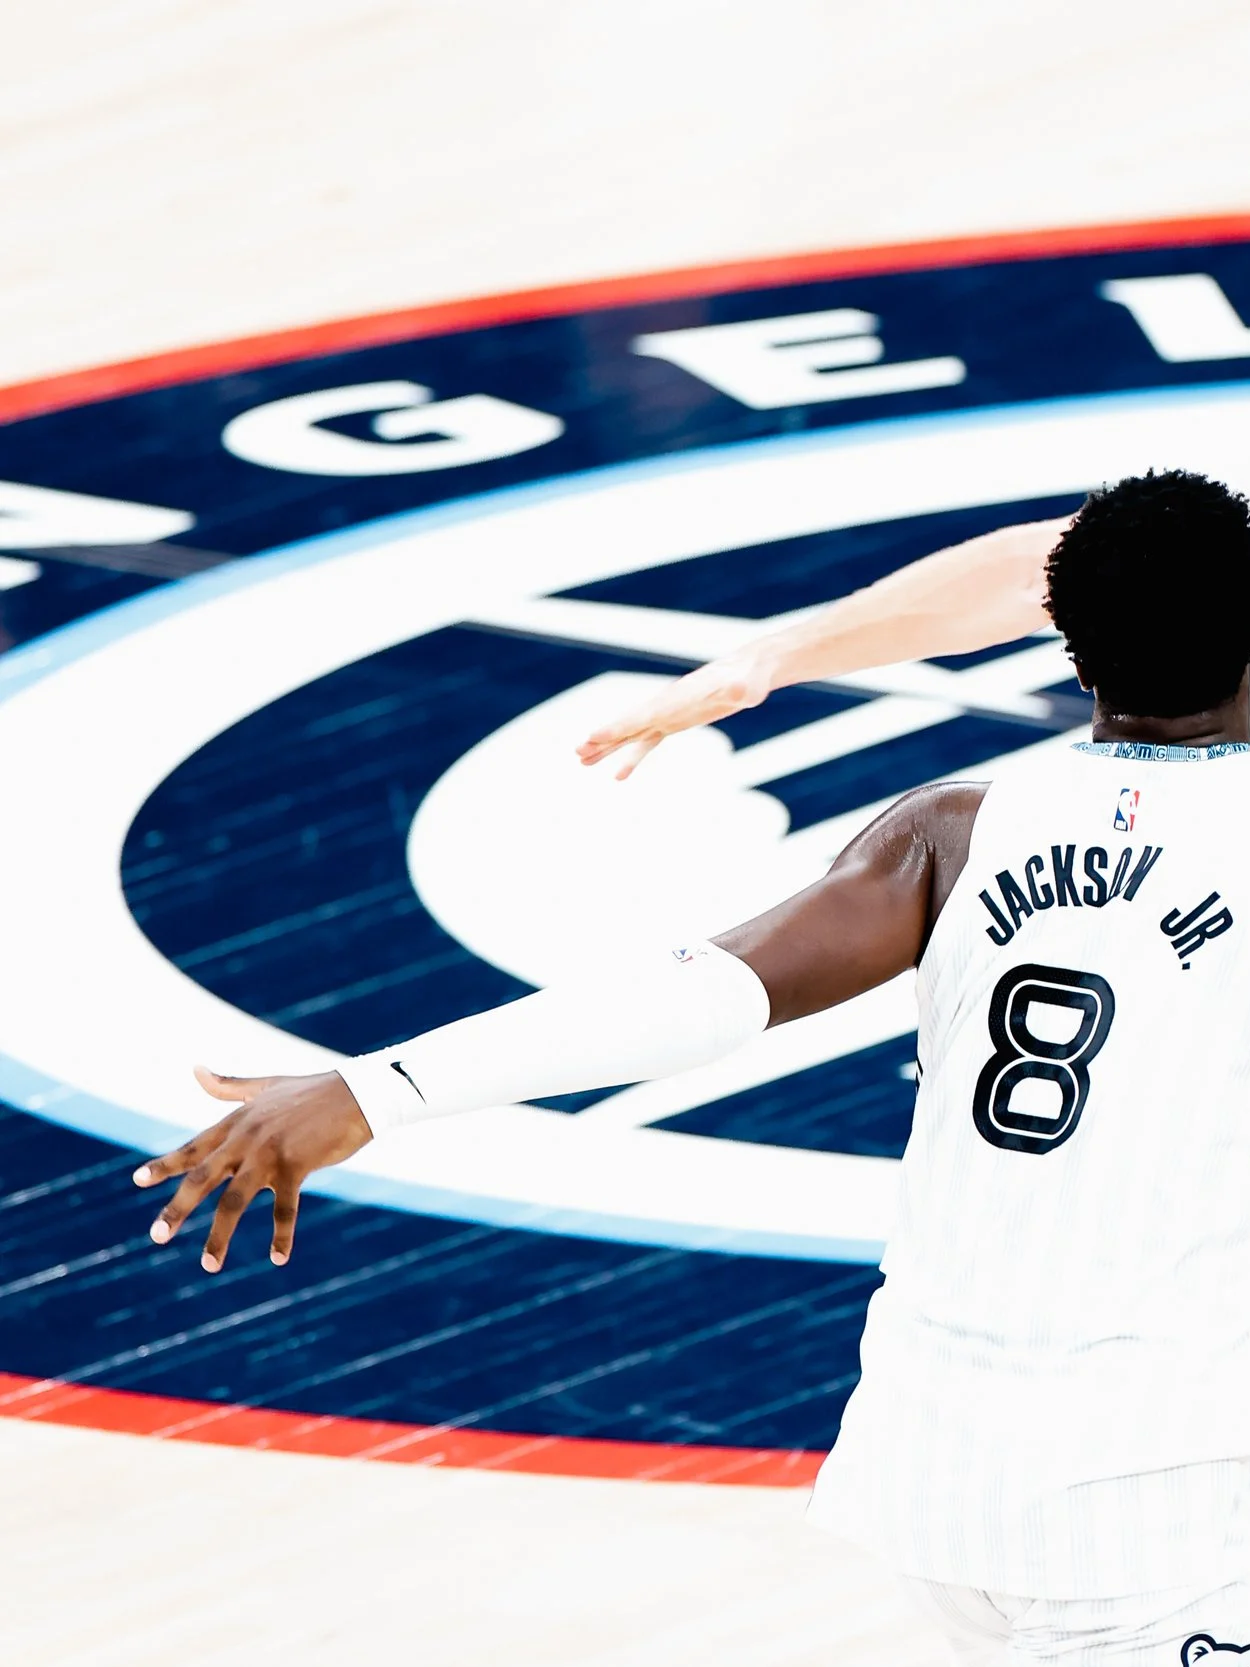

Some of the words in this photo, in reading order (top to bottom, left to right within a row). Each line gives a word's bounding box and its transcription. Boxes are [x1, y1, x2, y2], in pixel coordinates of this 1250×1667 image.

[979, 844, 1164, 946] JACKSON
[1160, 891, 1234, 970] JR.
[972, 963, 1116, 1156] 8
